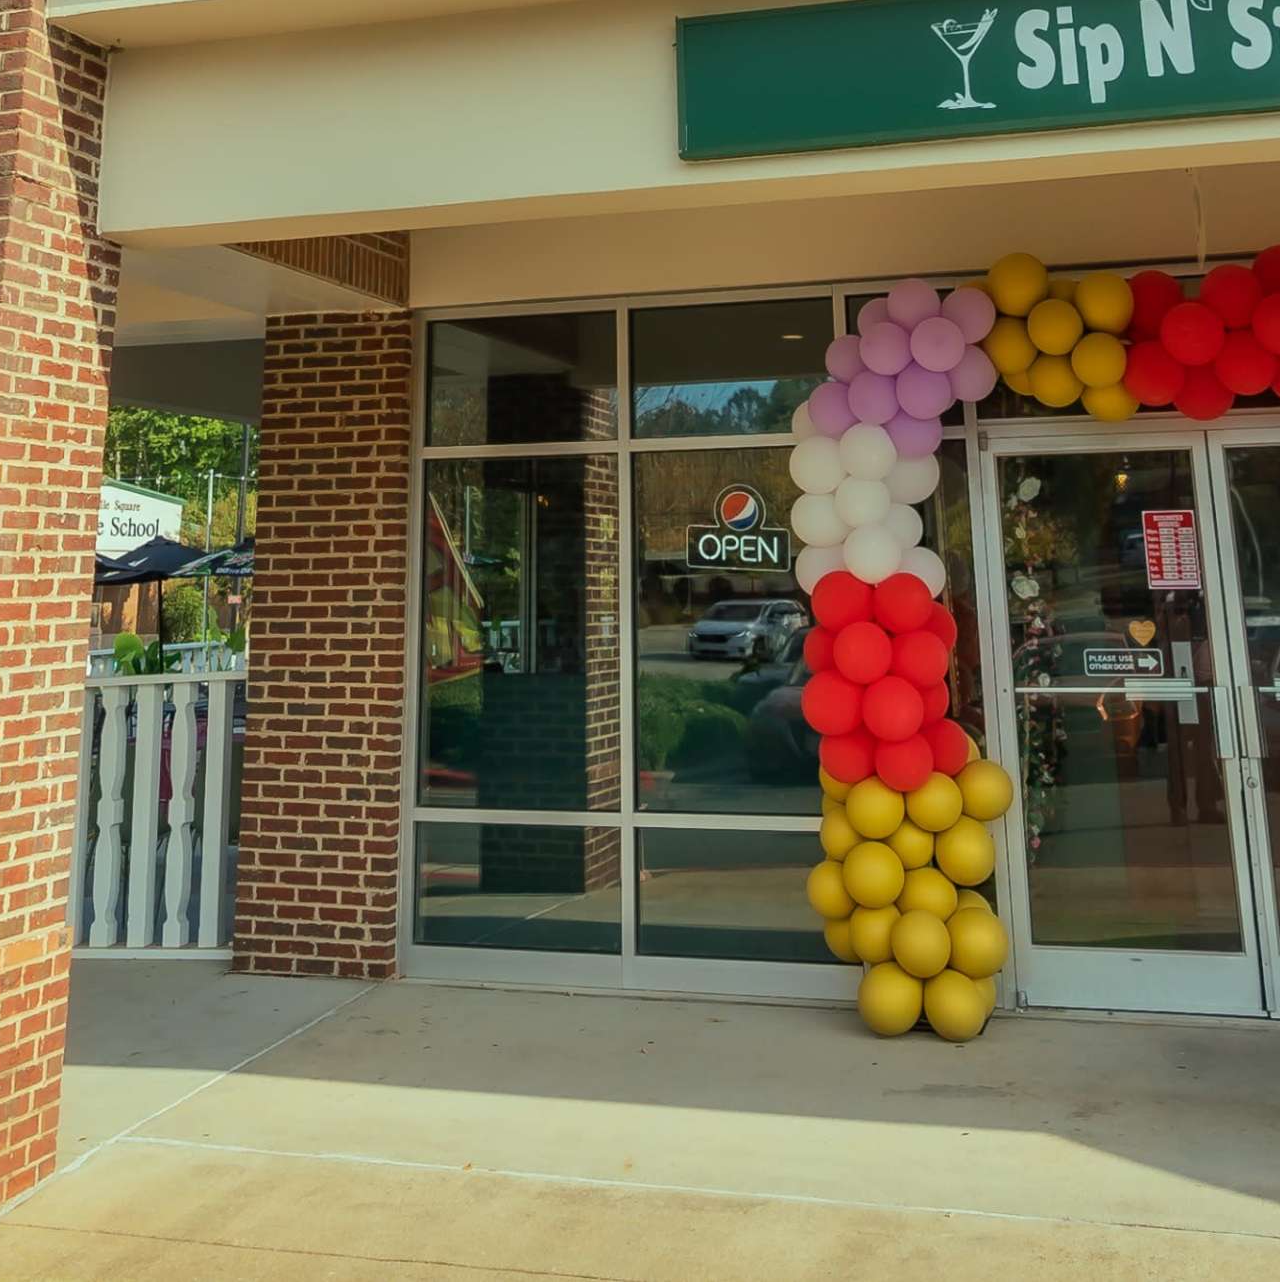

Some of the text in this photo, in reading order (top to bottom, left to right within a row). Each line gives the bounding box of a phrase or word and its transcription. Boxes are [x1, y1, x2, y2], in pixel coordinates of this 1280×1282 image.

[1014, 5, 1124, 104] Sip
[110, 517, 160, 537] School
[698, 534, 778, 563] OPEN
